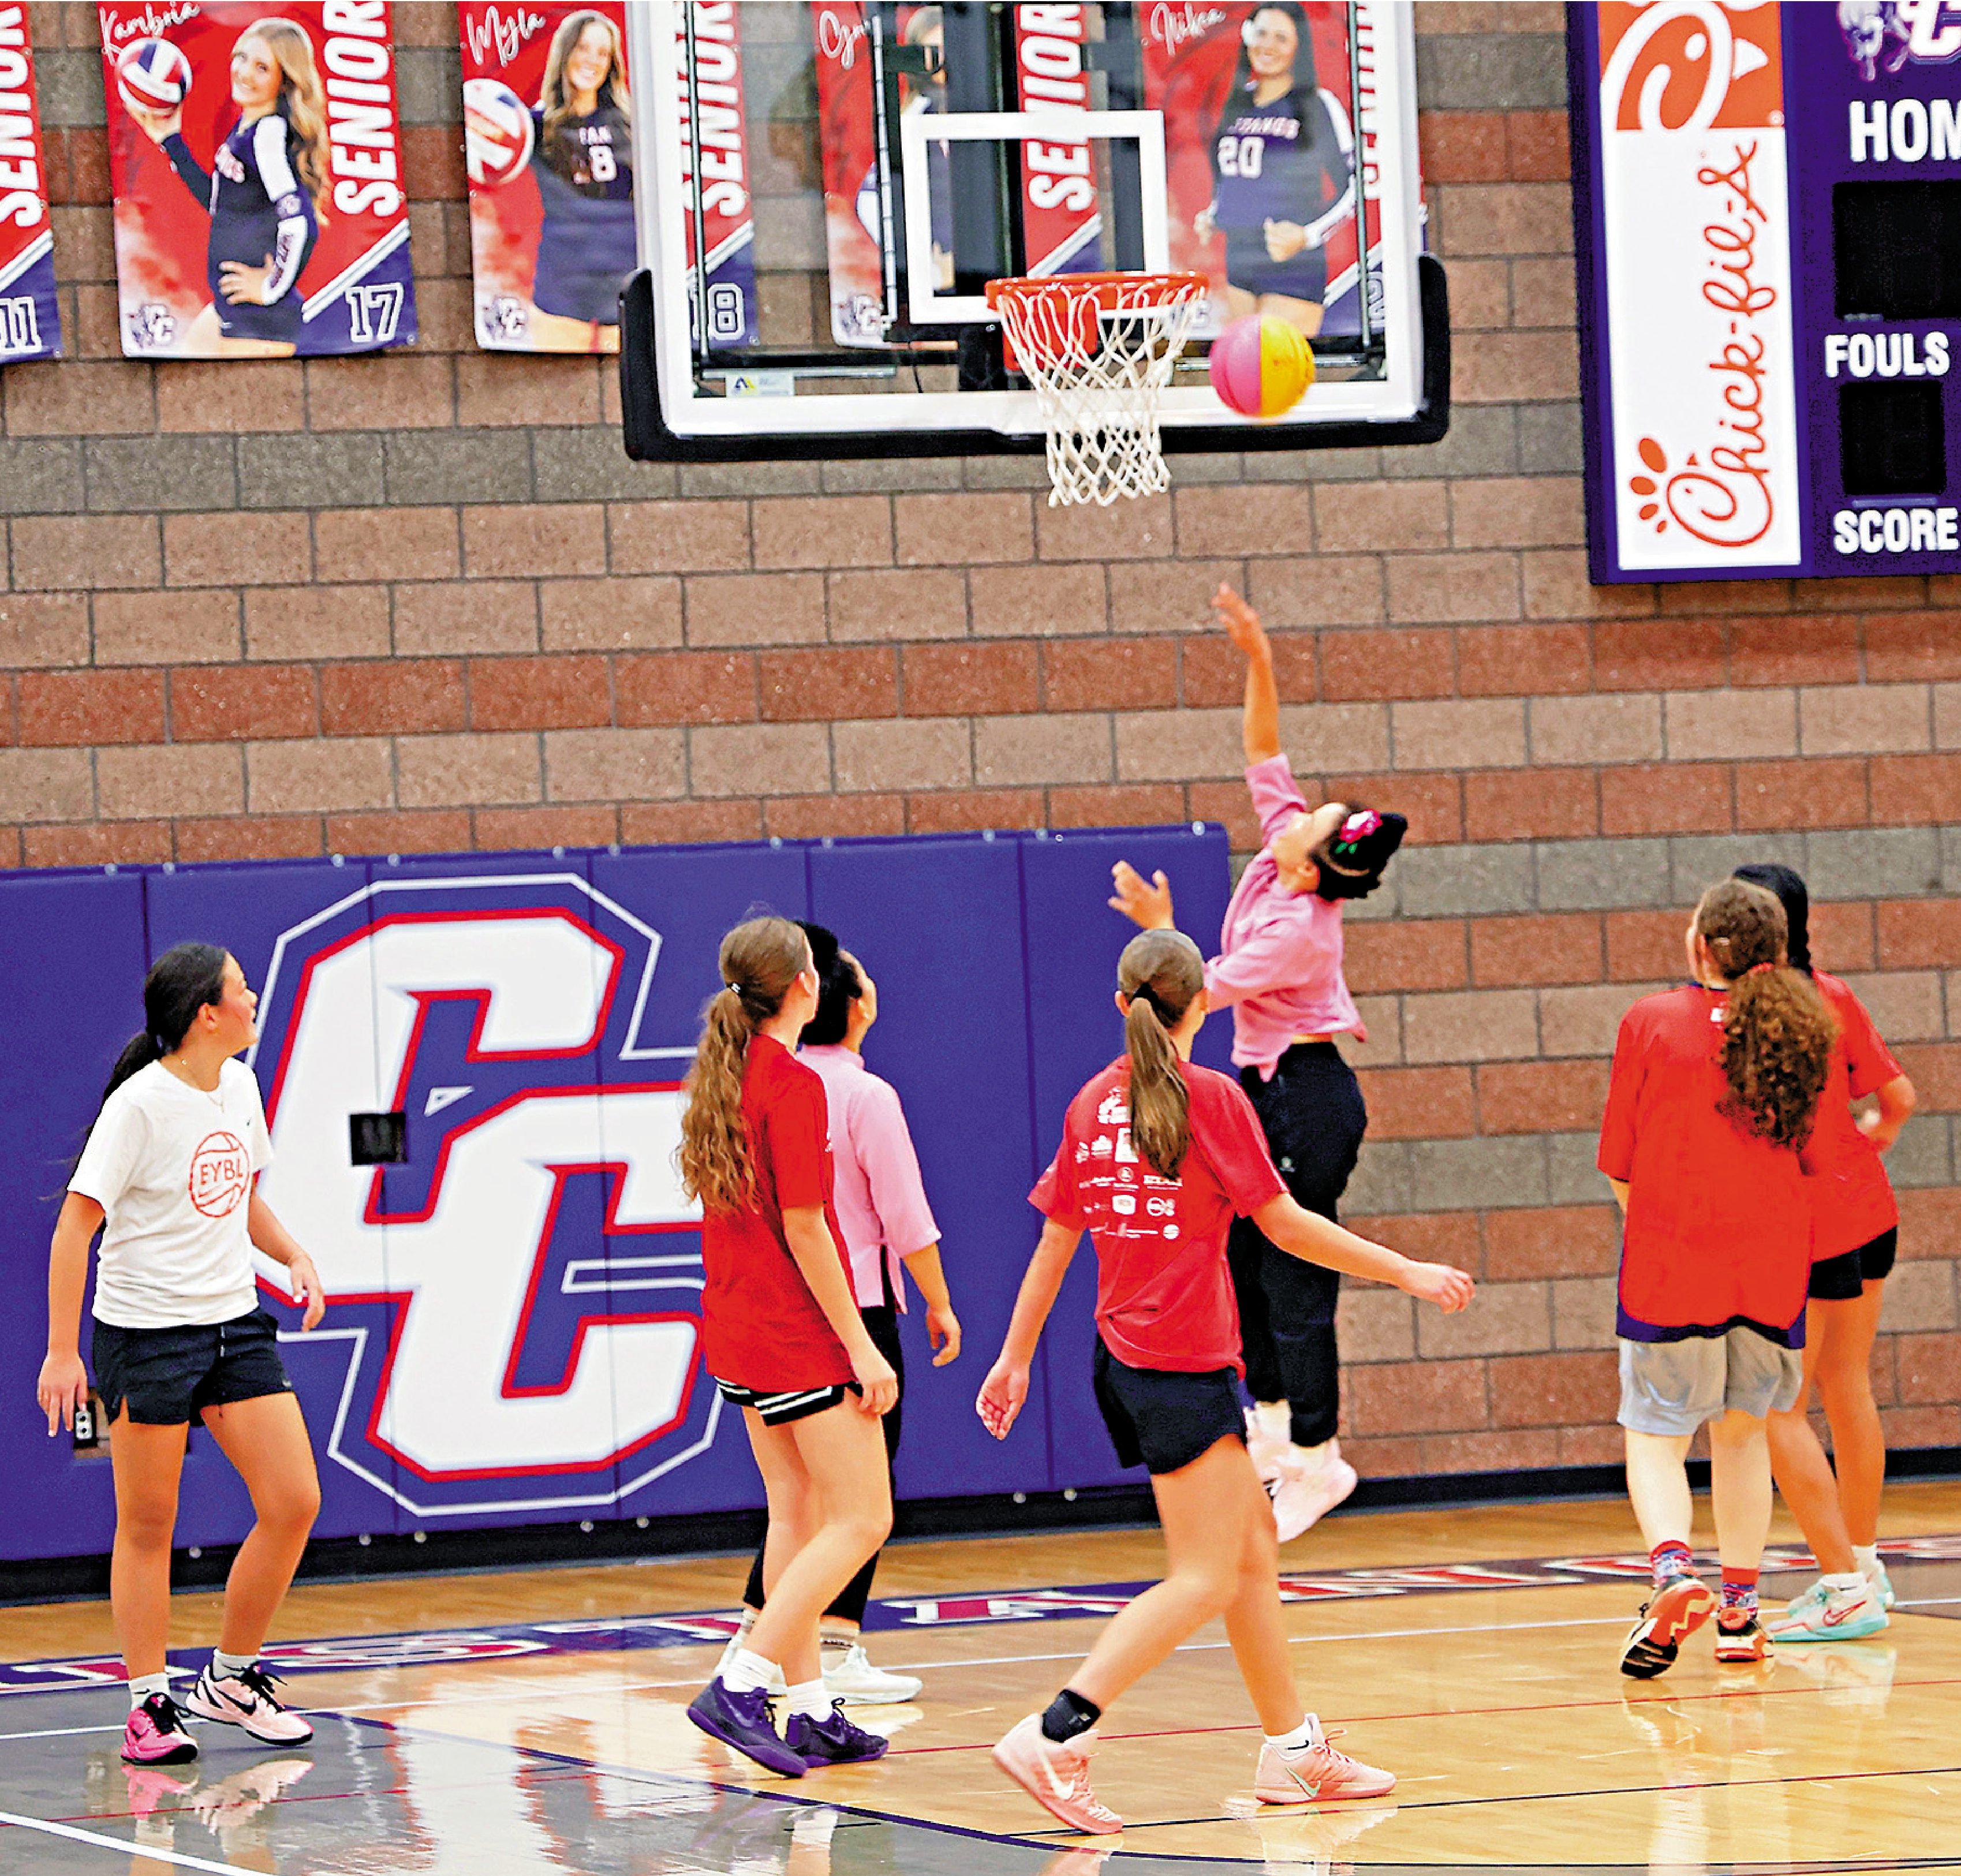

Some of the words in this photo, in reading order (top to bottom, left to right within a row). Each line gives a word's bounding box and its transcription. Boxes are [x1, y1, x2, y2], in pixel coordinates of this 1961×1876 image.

[99, 2, 201, 66] Kambria
[466, 6, 546, 68] Myla
[324, 2, 401, 216] SENIOR
[1848, 99, 1961, 162] HOM
[1217, 136, 1264, 178] 20
[346, 283, 404, 342] 17
[1824, 331, 1950, 378] FOULS
[1833, 507, 1959, 554] SCORE
[200, 1156, 243, 1185] EYBL
